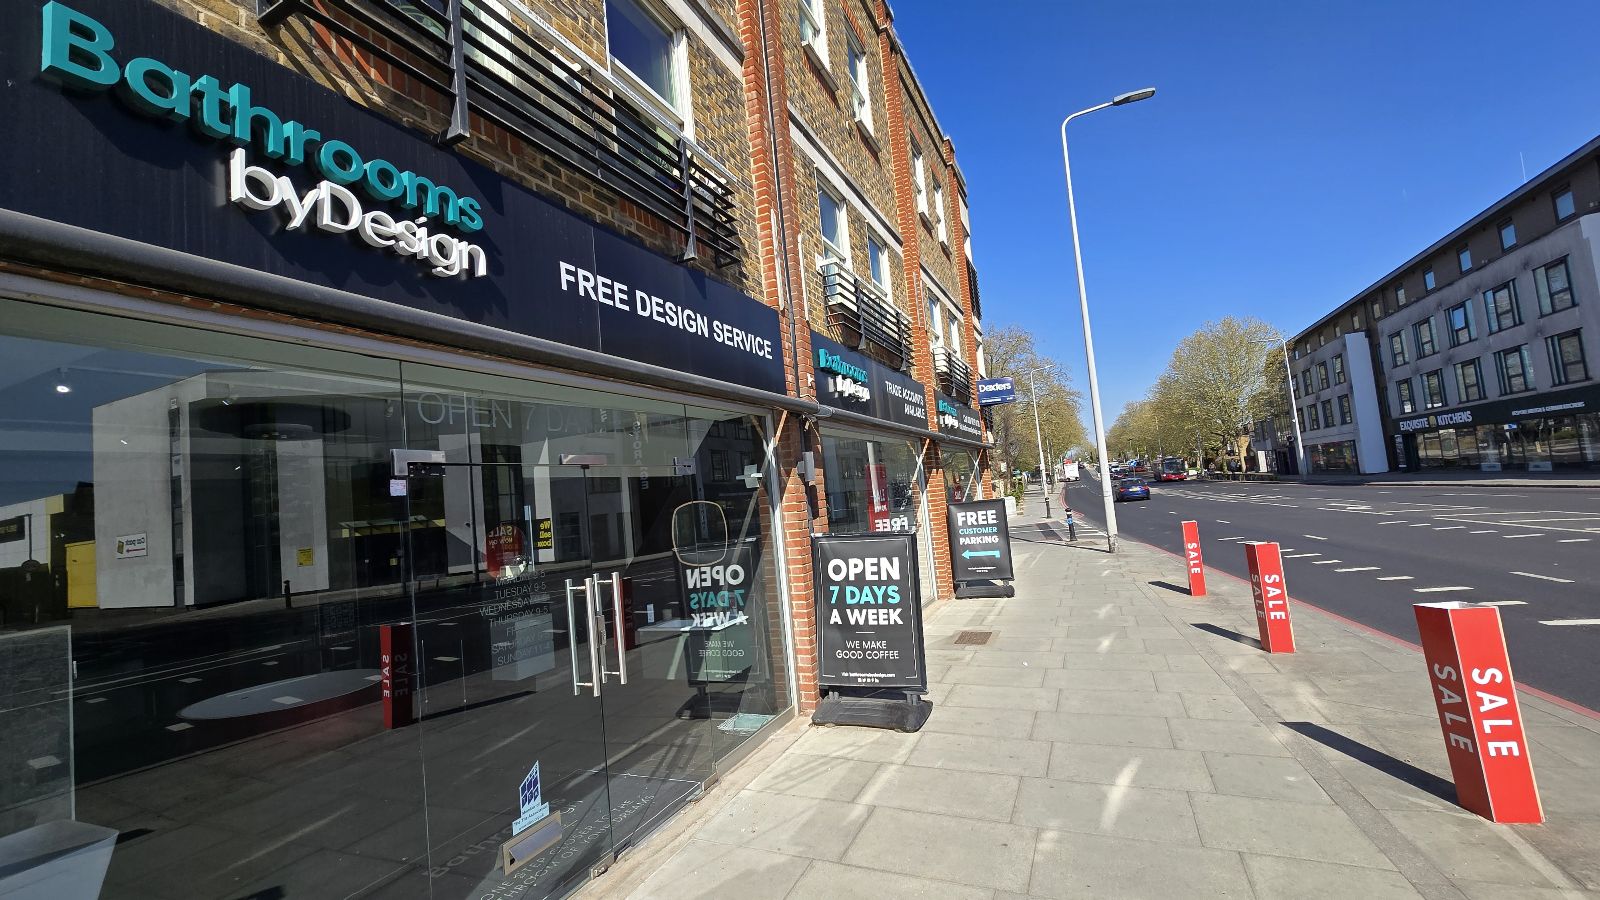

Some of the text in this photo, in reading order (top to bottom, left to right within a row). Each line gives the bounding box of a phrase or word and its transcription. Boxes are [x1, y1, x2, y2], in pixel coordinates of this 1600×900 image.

[41, 0, 484, 232] Bathrooms
[230, 147, 487, 278] byDesign
[559, 261, 773, 359] FREE DESIGN SERVICE
[885, 380, 902, 398] TRADE
[417, 392, 512, 430] OPEN
[1400, 410, 1473, 432] EXQUISITE KITCHENS
[956, 509, 997, 527] FREE
[959, 526, 998, 535] CUSTOMER
[959, 535, 999, 546] PARKING
[827, 556, 901, 582] OPEN
[1187, 542, 1201, 574] SALE
[495, 583, 533, 600] TUESDAY
[829, 585, 901, 605] 7 DAYS
[1251, 573, 1266, 619] SALE
[1264, 574, 1286, 620] SALE
[480, 597, 533, 617] WEDNESDAY
[829, 607, 904, 626] A WEEK
[835, 650, 900, 660] GOOD COFFEE
[846, 640, 887, 649] WE MAKE
[1433, 663, 1474, 753] SALE
[1471, 667, 1520, 757] SALE
